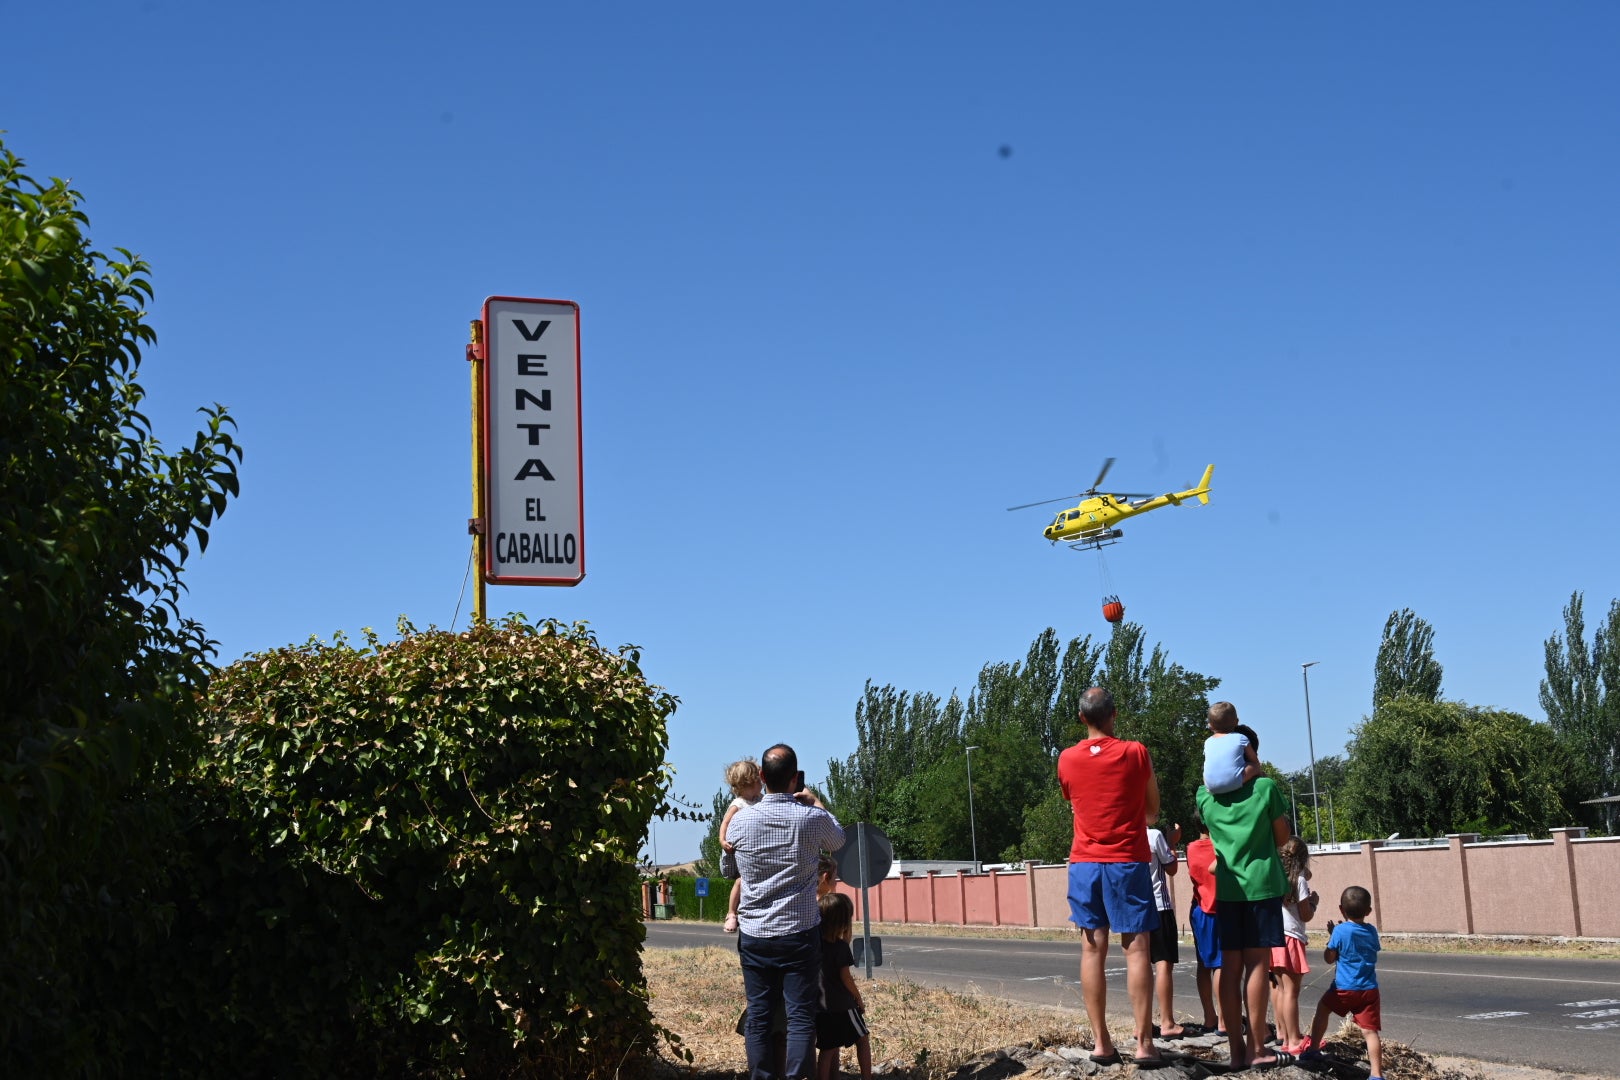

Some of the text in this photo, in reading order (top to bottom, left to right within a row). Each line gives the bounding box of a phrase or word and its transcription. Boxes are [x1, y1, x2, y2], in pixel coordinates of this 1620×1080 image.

[512, 319, 556, 481] VENTA
[525, 498, 546, 521] EL
[1102, 496, 1110, 506] 8
[495, 532, 576, 565] CABALLO
